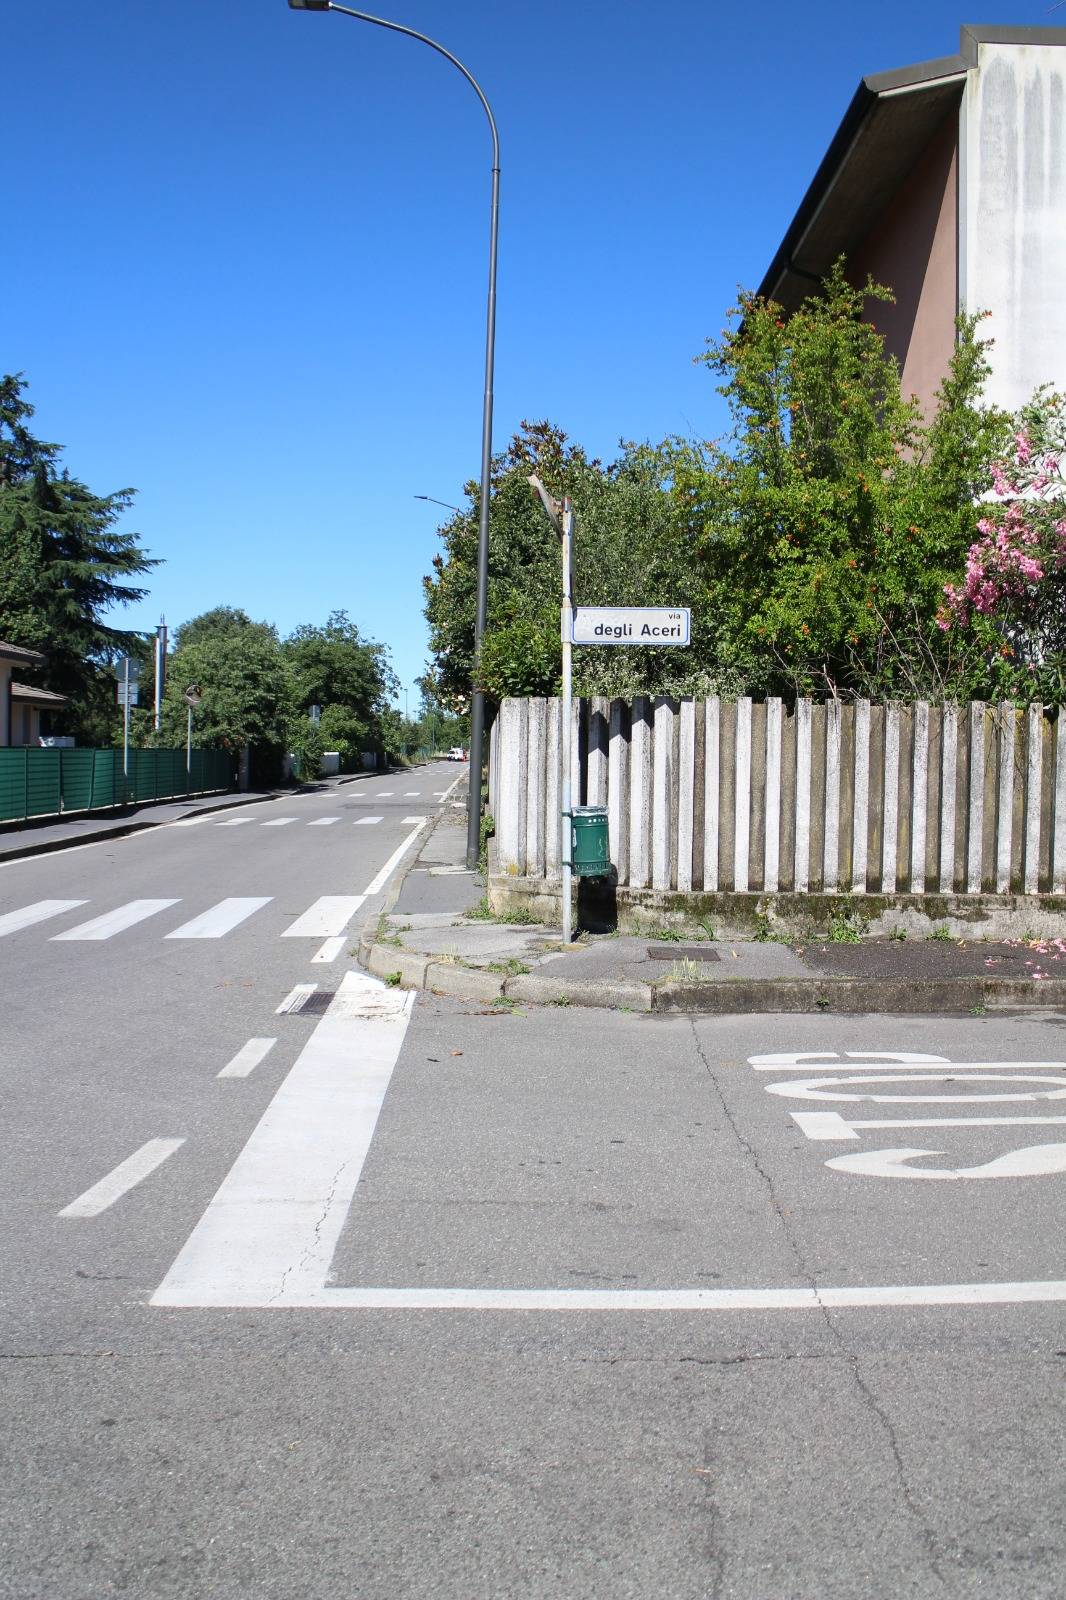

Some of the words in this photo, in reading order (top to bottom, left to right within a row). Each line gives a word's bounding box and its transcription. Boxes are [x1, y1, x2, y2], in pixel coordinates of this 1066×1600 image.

[668, 612, 681, 620] via
[594, 623, 632, 638] degli
[640, 623, 681, 637] Aceri
